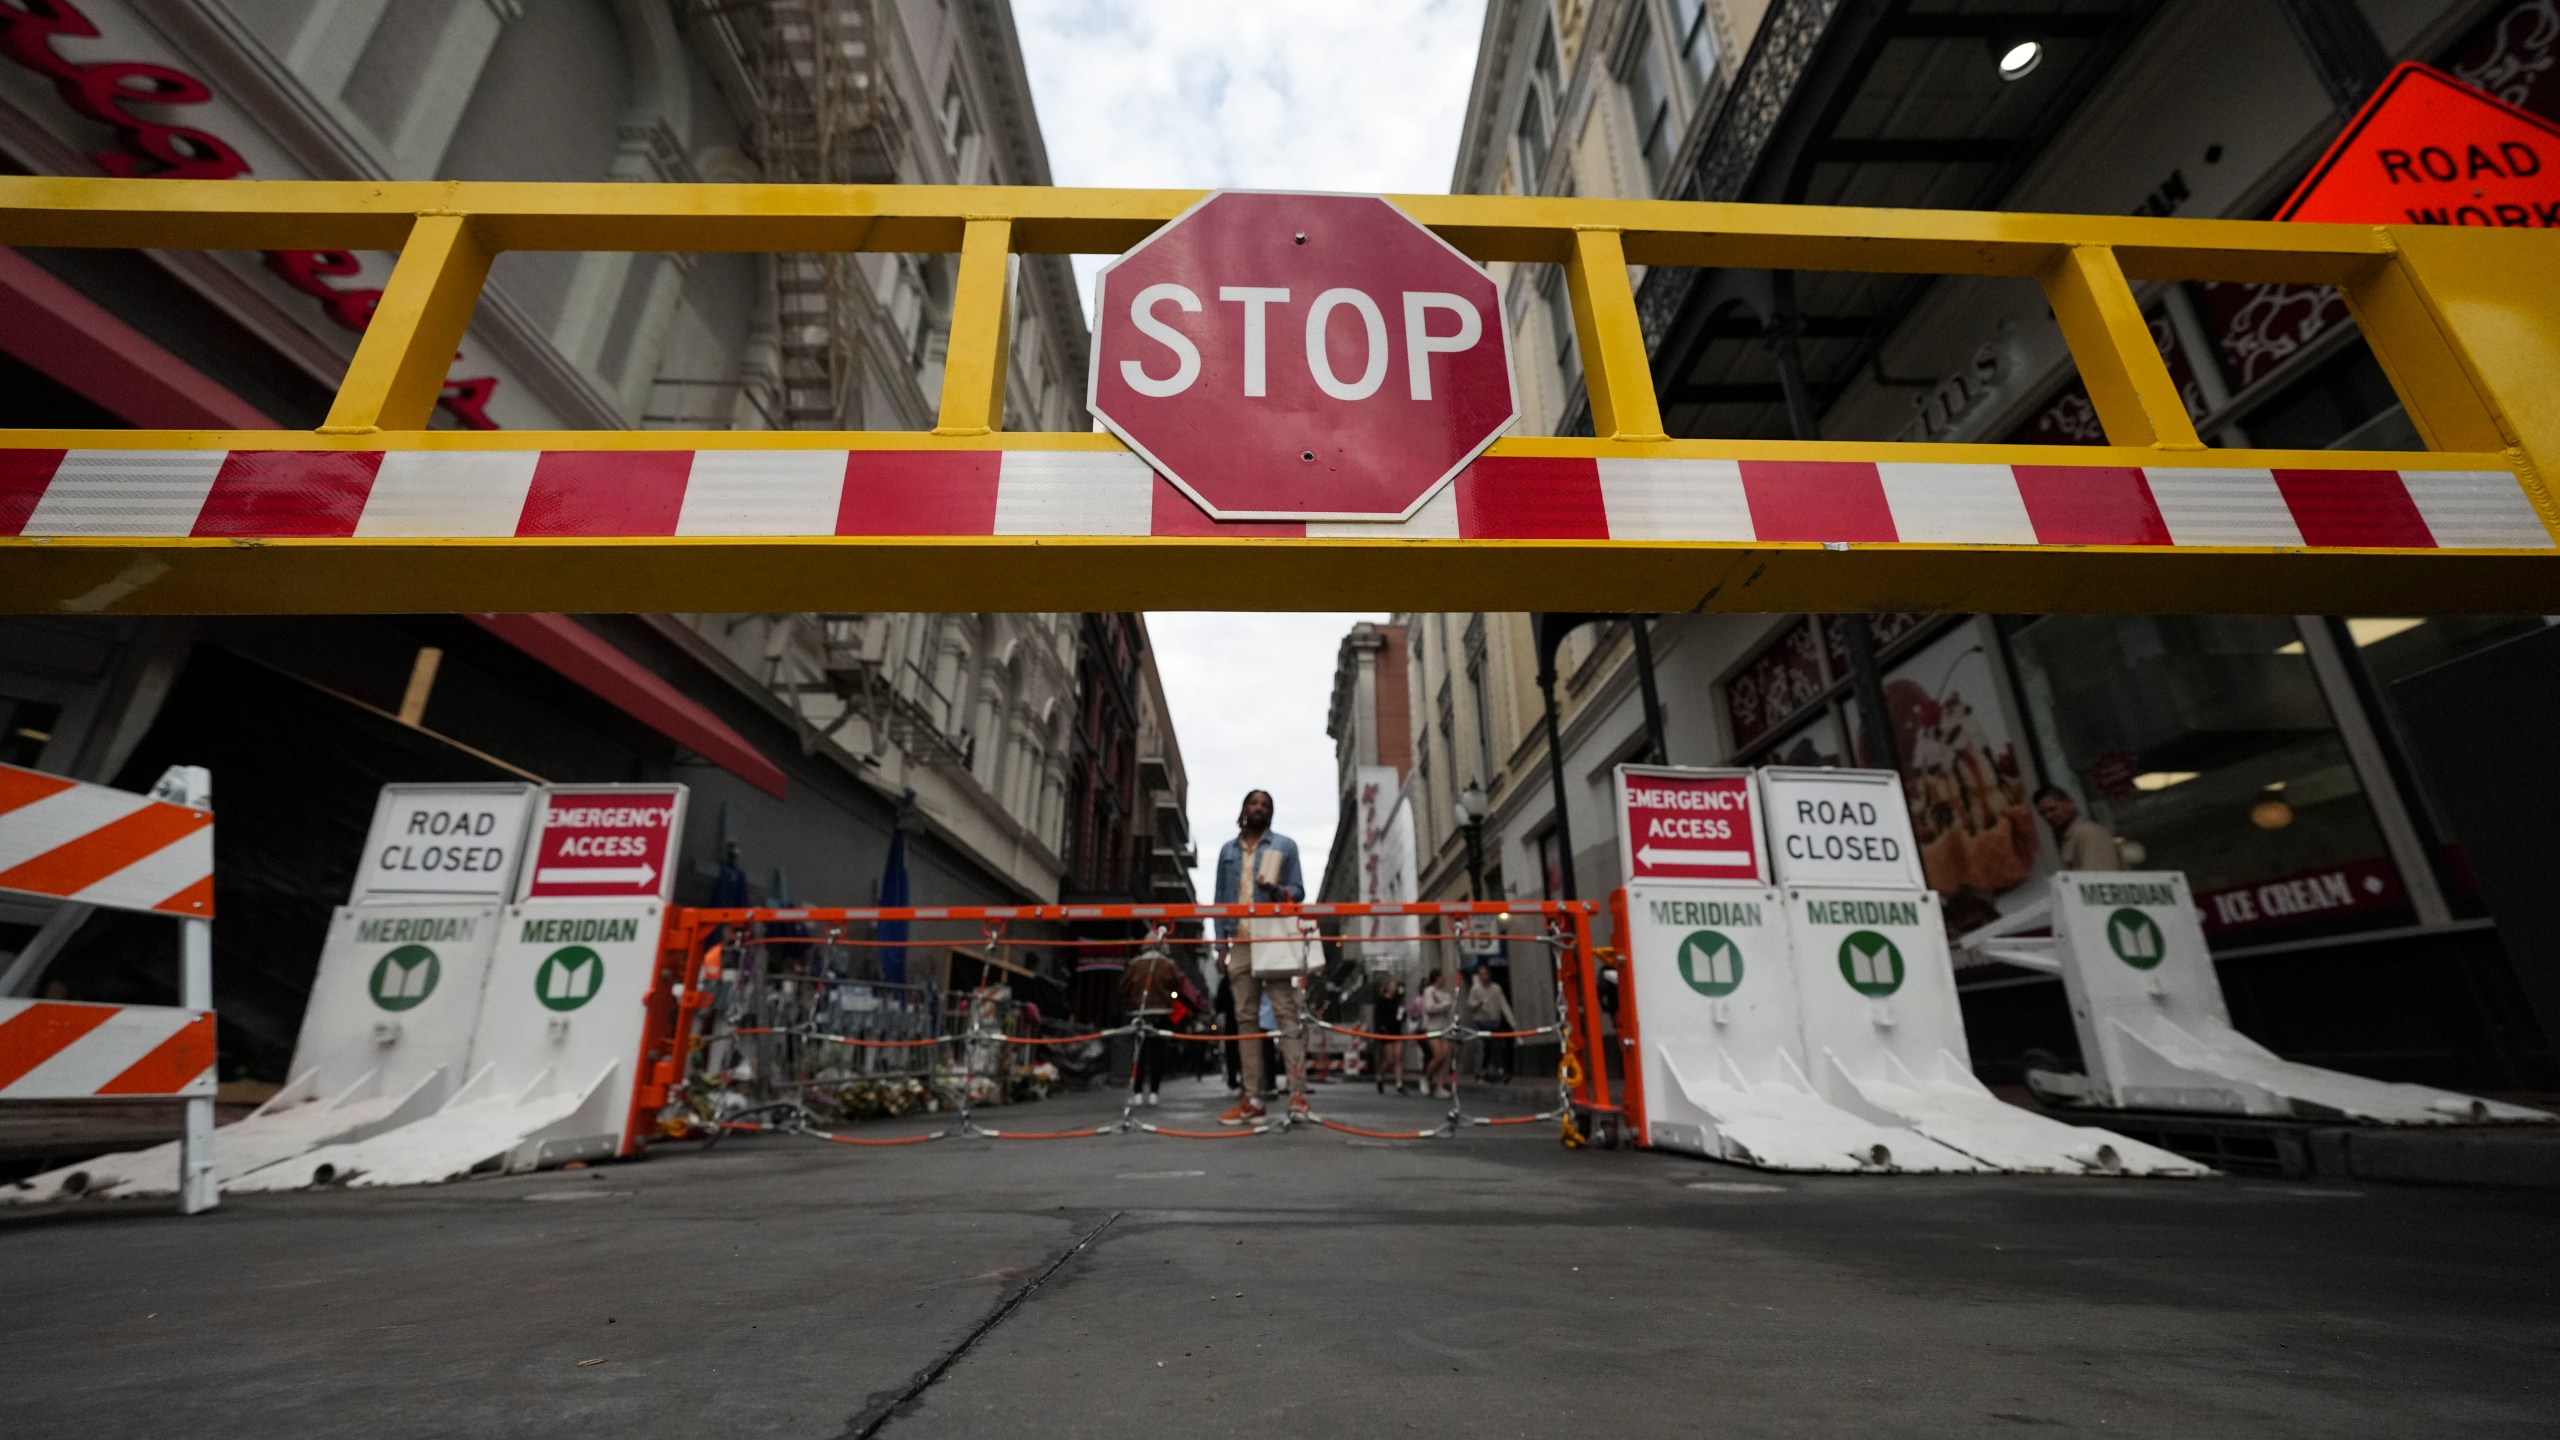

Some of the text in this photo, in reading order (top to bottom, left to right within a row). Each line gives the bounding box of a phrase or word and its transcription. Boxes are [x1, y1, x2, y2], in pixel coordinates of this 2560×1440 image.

[2378, 142, 2541, 184] ROAD
[1120, 283, 1483, 401] STOP
[1626, 789, 1748, 811] EMERGENCY
[406, 811, 496, 836] ROAD
[545, 808, 674, 828] EMERGENCY
[1797, 800, 1877, 826] ROAD
[1649, 818, 1732, 840] ACCESS
[380, 846, 506, 872] CLOSED
[558, 836, 648, 857] ACCESS
[1786, 835, 1900, 862] CLOSED
[2078, 883, 2177, 906] MERIDIAN
[2214, 872, 2355, 925] ICE CREAM
[1650, 901, 1763, 927] MERIDIAN
[1807, 901, 1920, 926] MERIDIAN
[354, 918, 475, 944] MERIDIAN
[520, 919, 640, 943] MERIDIAN
